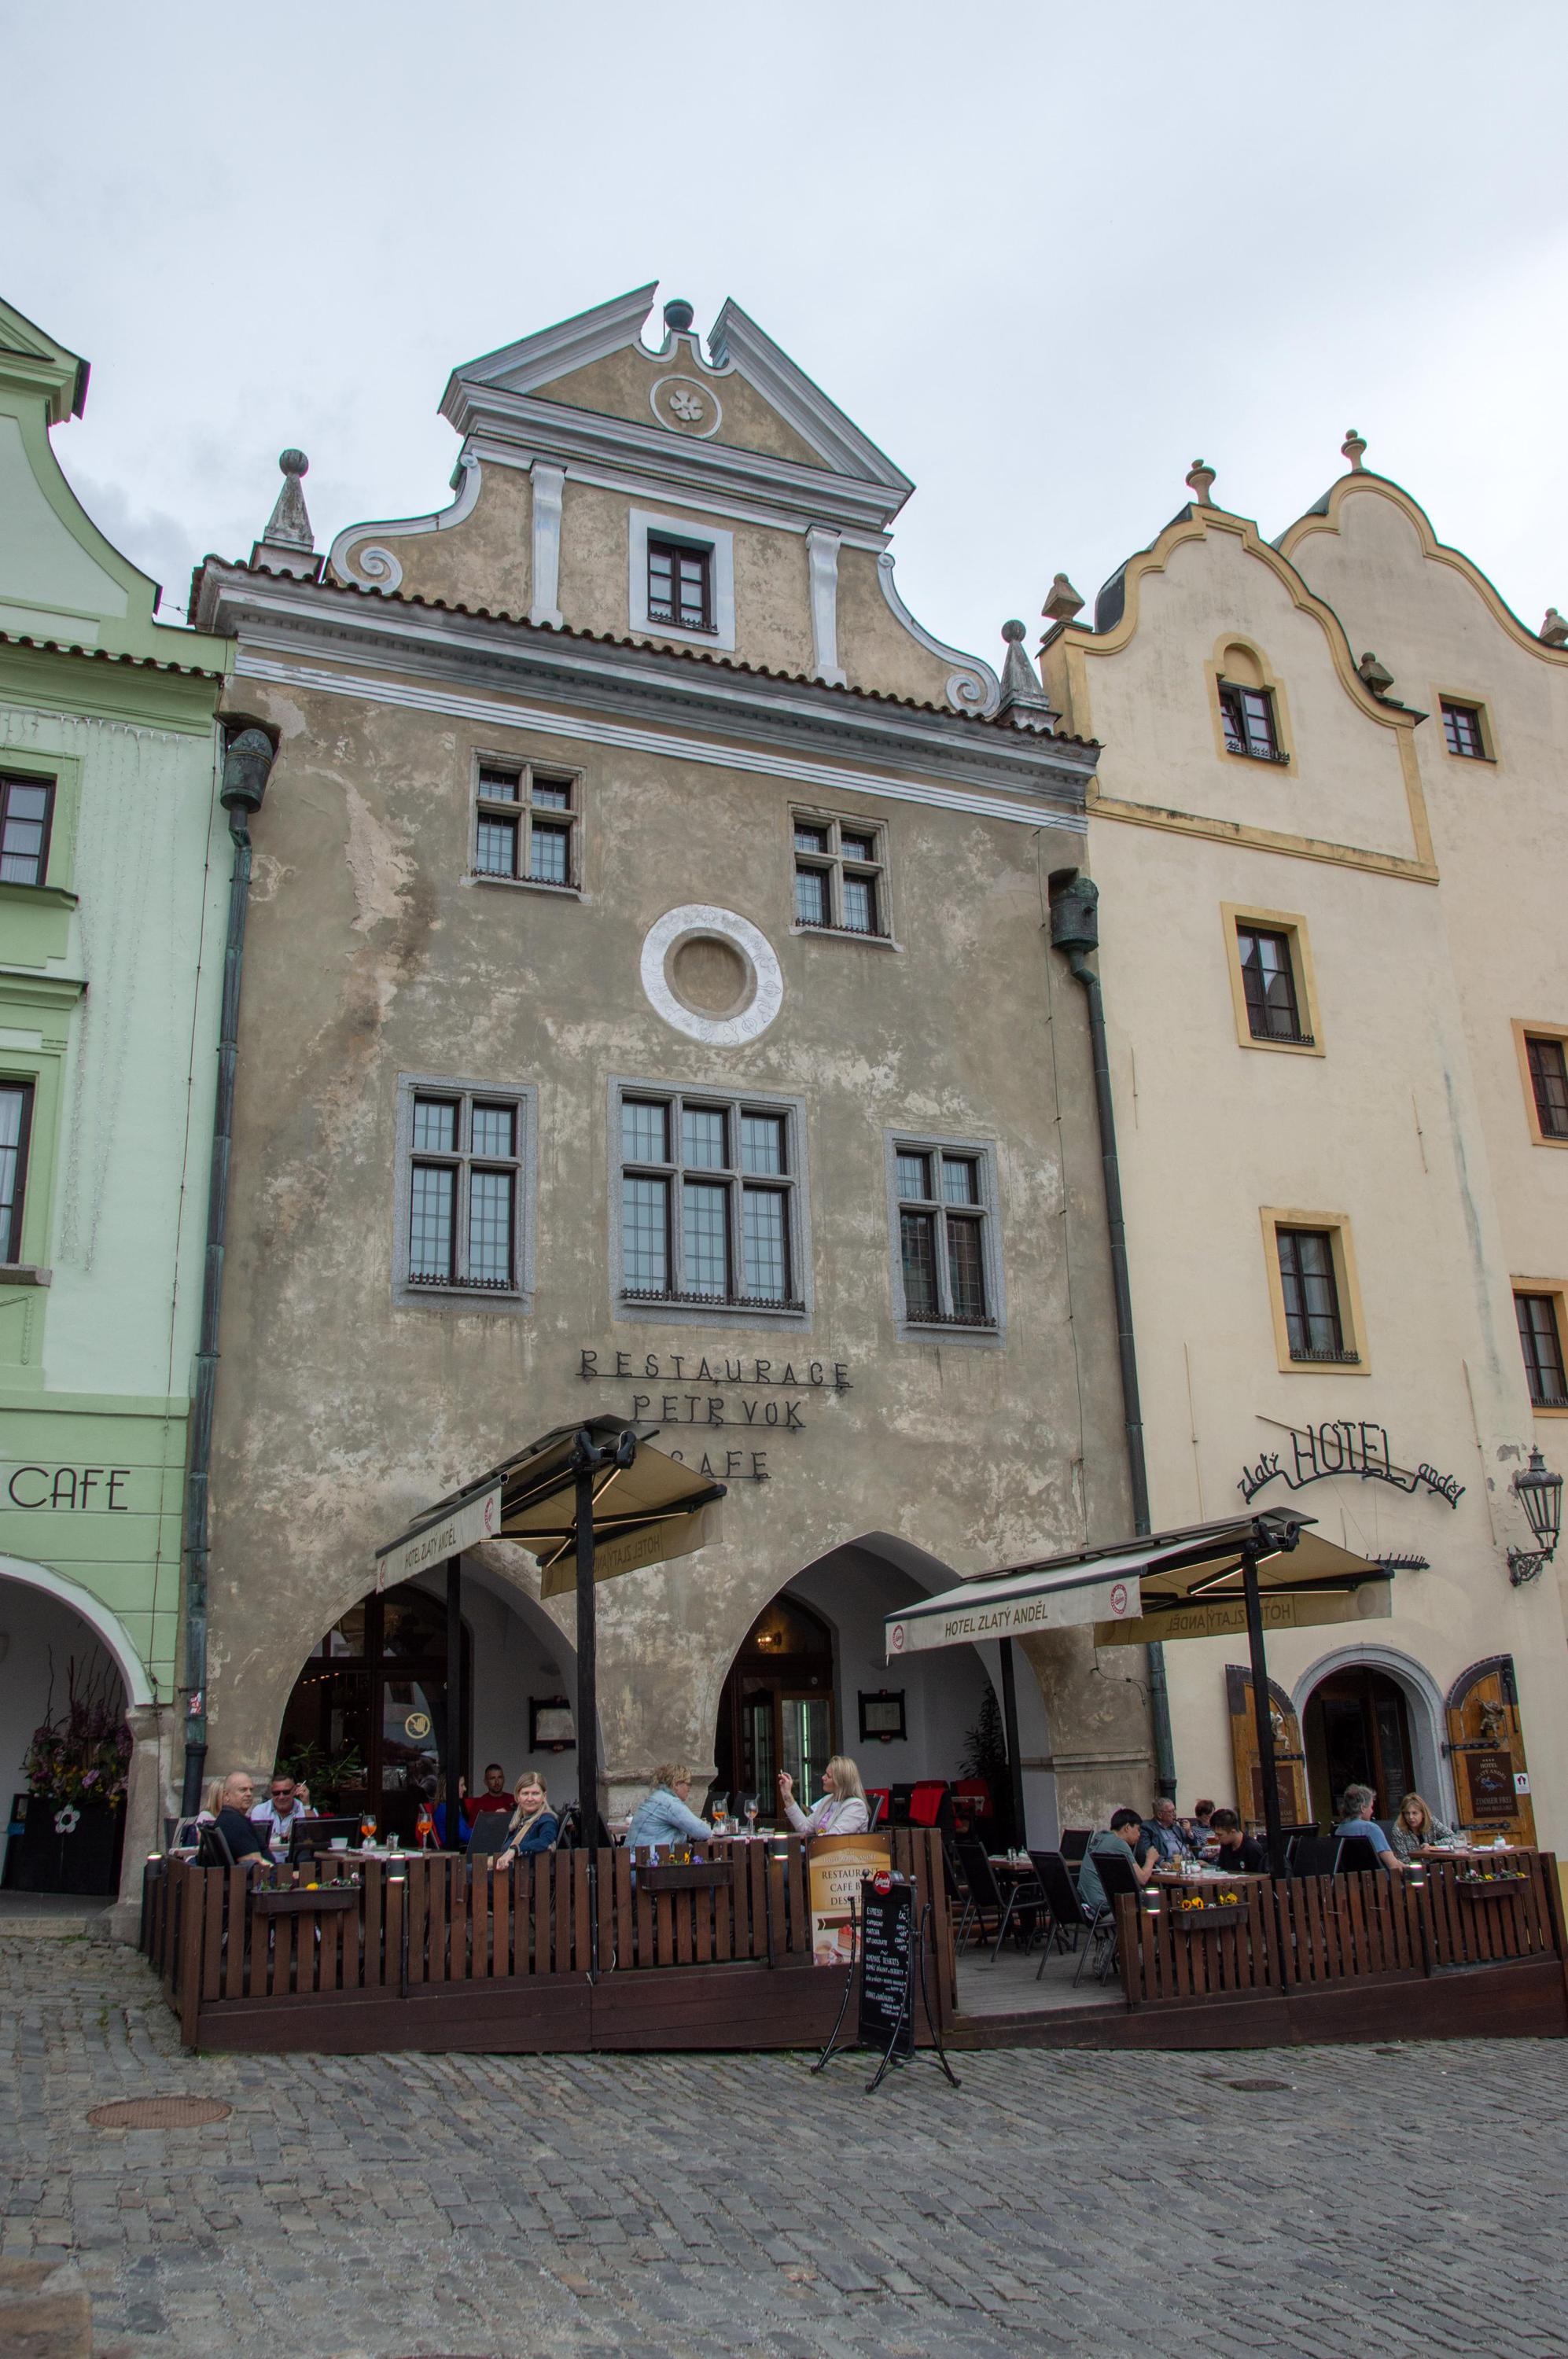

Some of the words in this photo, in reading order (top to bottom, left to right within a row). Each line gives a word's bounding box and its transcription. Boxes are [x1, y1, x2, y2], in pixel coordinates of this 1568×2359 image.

[580, 1349, 850, 1386] RESTAURACE
[632, 1395, 724, 1422] PETR
[742, 1400, 803, 1426] VOK
[1290, 1419, 1406, 1484] HOTEL
[1418, 1463, 1466, 1502] anděl
[9, 1467, 131, 1510] CAFE
[404, 1547, 421, 1569] HOTEL
[944, 1617, 975, 1637] HOTEL
[977, 1606, 1011, 1631] ZLATÝ
[1013, 1600, 1048, 1625] ANDĚL
[822, 1868, 880, 1880] RESTAURNT
